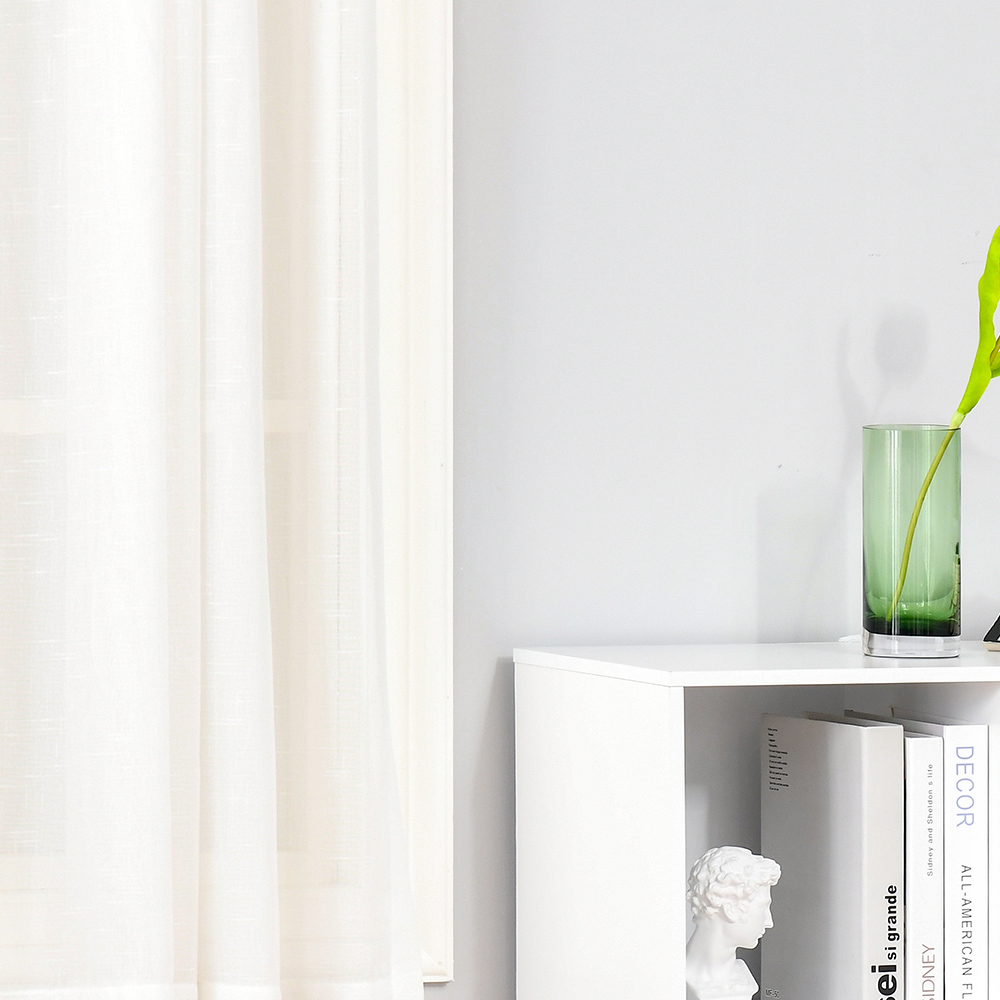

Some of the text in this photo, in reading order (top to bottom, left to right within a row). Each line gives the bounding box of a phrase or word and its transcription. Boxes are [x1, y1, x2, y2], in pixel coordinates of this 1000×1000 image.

[956, 746, 974, 828] DECOR
[884, 885, 900, 942] grande
[961, 864, 973, 976] ALL-AMERICAN
[885, 946, 897, 960] si
